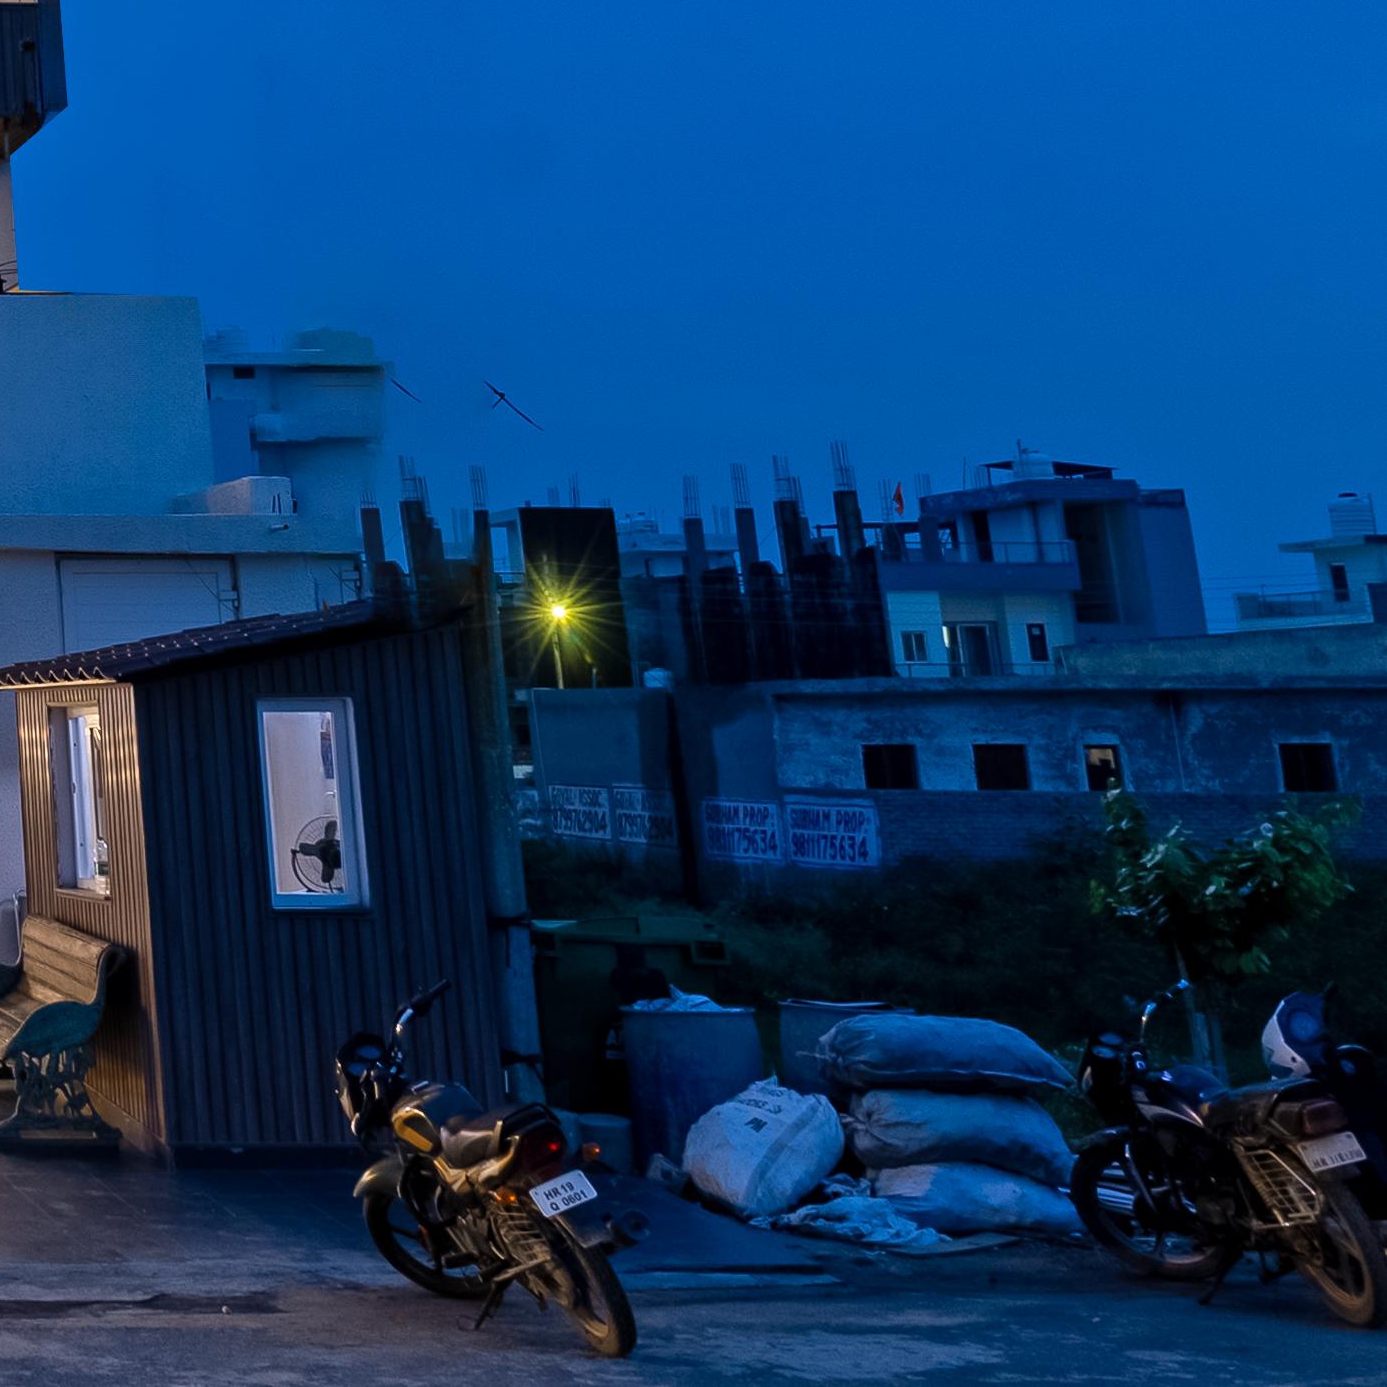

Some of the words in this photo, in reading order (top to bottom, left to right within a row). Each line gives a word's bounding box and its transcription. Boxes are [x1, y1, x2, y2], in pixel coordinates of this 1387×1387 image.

[791, 832, 869, 863] 9811175634
[543, 1187, 562, 1201] HR
[549, 1201, 560, 1211] Q
[561, 1189, 588, 1206] 0601
